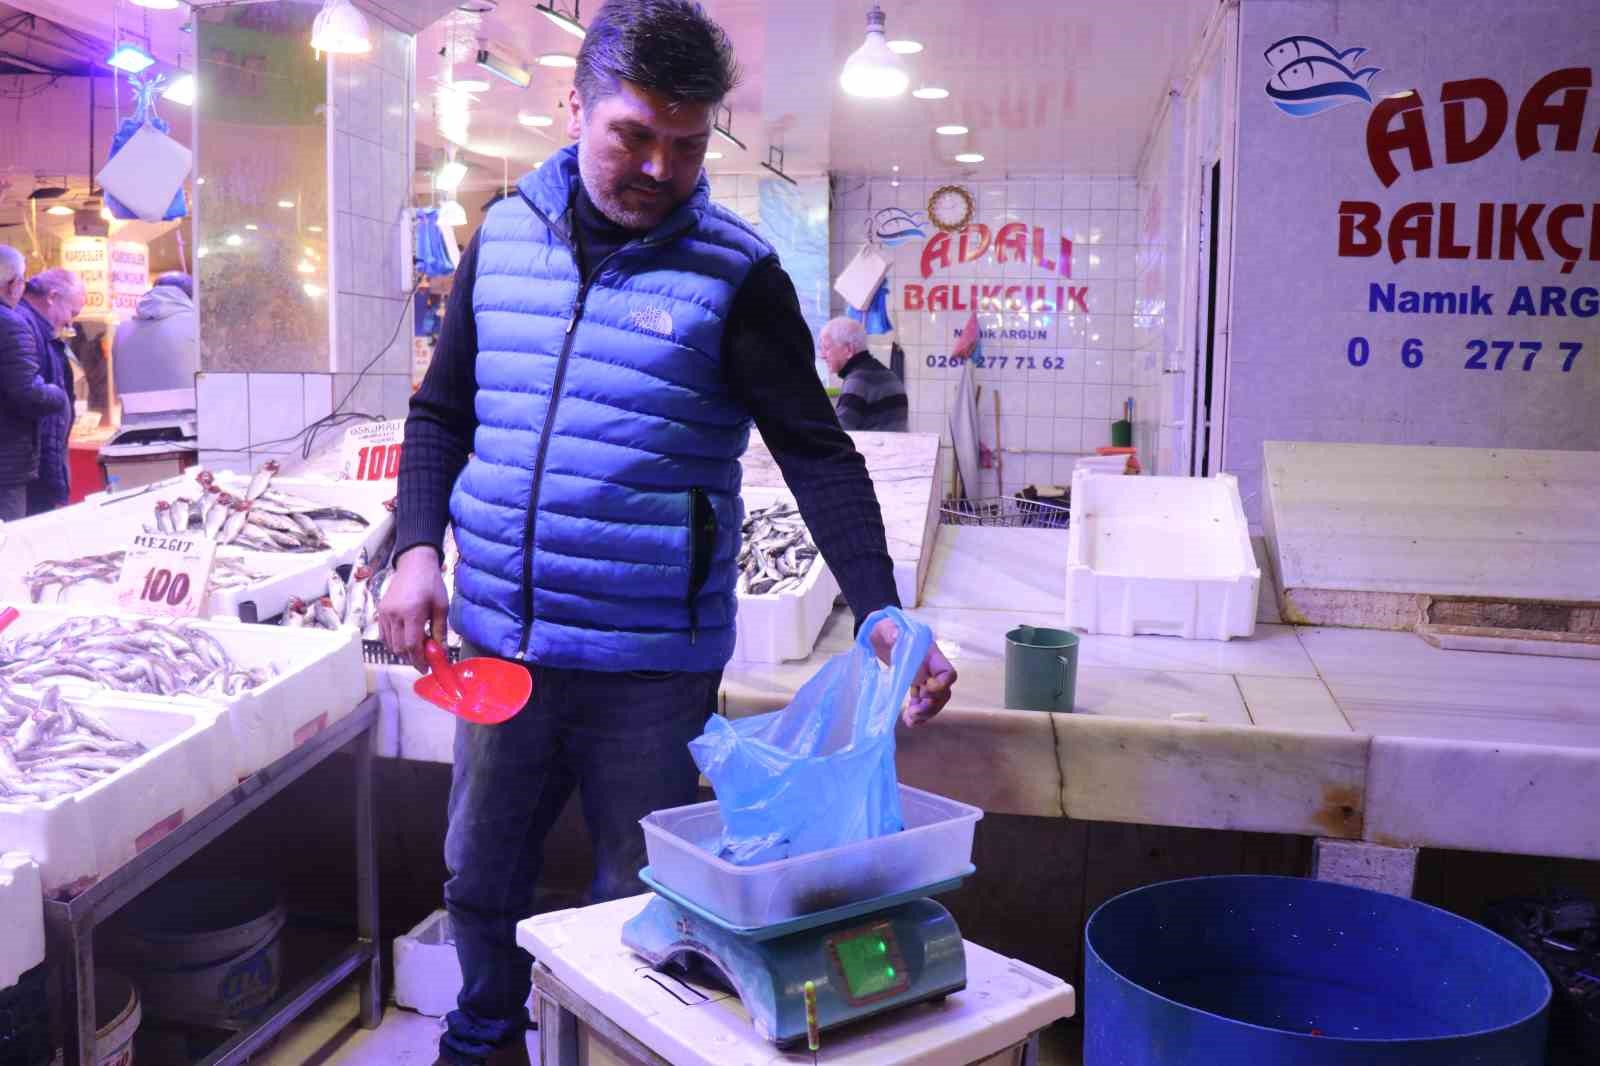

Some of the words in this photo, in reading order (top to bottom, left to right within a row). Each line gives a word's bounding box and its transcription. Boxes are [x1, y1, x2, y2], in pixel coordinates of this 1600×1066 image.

[1366, 67, 1600, 189] ADA
[920, 222, 1073, 279] ADALI
[1368, 283, 1494, 316] Namık
[1000, 330, 1048, 340] ARGUN
[1015, 357, 1036, 369] 71
[1042, 357, 1065, 370] 62
[1464, 339, 1542, 371] 277
[357, 444, 402, 481] 100
[140, 567, 190, 606] 100
